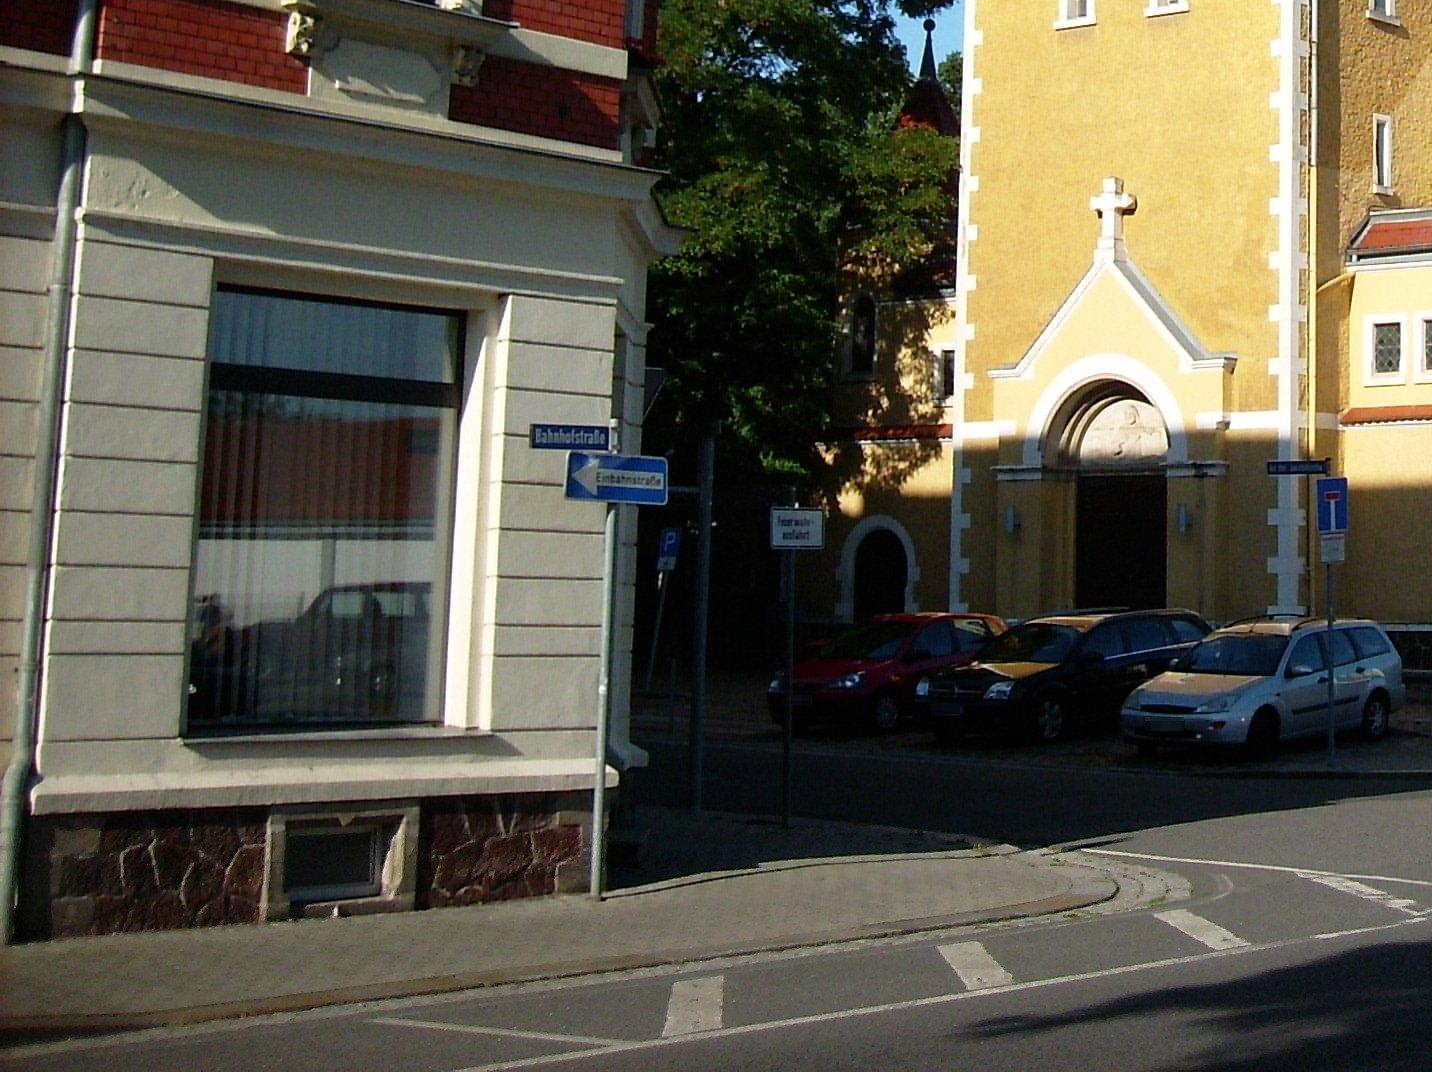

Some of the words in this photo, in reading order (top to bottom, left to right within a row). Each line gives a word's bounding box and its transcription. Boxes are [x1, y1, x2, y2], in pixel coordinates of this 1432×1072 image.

[535, 427, 606, 444] Bahnhofstraße
[596, 471, 661, 486] Einbahnstraße
[664, 531, 677, 552] P
